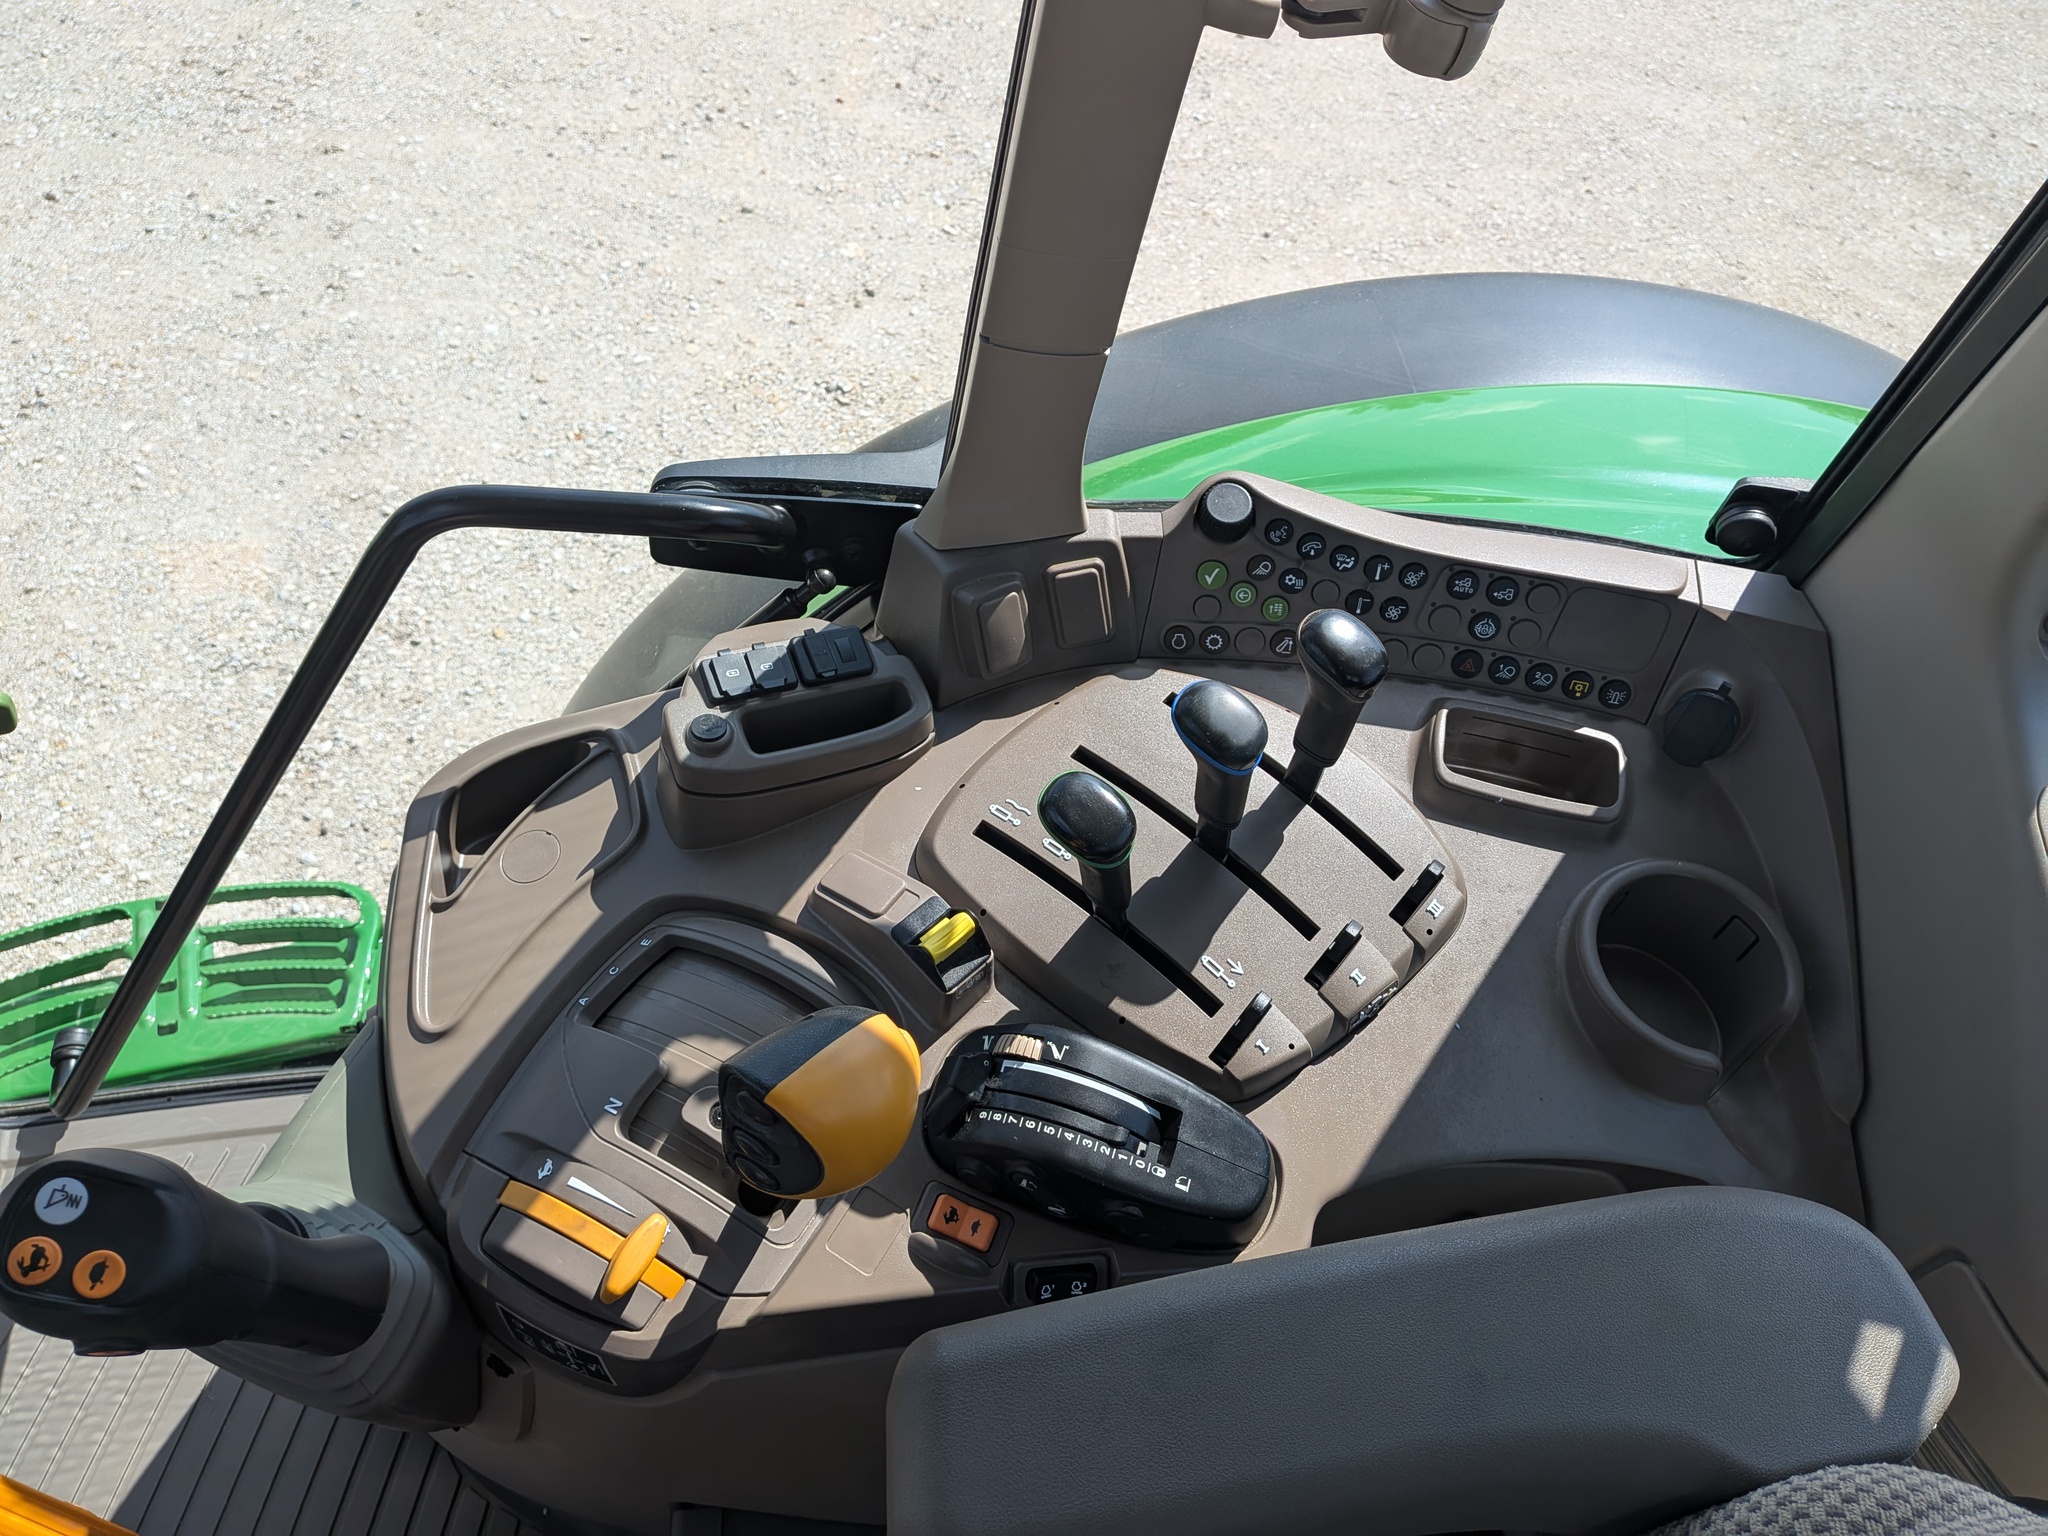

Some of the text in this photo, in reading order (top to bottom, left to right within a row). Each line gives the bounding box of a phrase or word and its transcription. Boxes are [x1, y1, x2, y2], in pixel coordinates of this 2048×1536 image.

[1453, 585, 1474, 594] AUTO
[1499, 663, 1504, 671] 1
[1535, 671, 1542, 679] 2
[640, 938, 652, 947] E
[608, 965, 620, 976] C
[1349, 968, 1367, 987] II
[578, 996, 589, 1006] A
[603, 1097, 623, 1115] N
[978, 1111, 1146, 1169] 9 8 7 6 5 4 3 2 1 0
